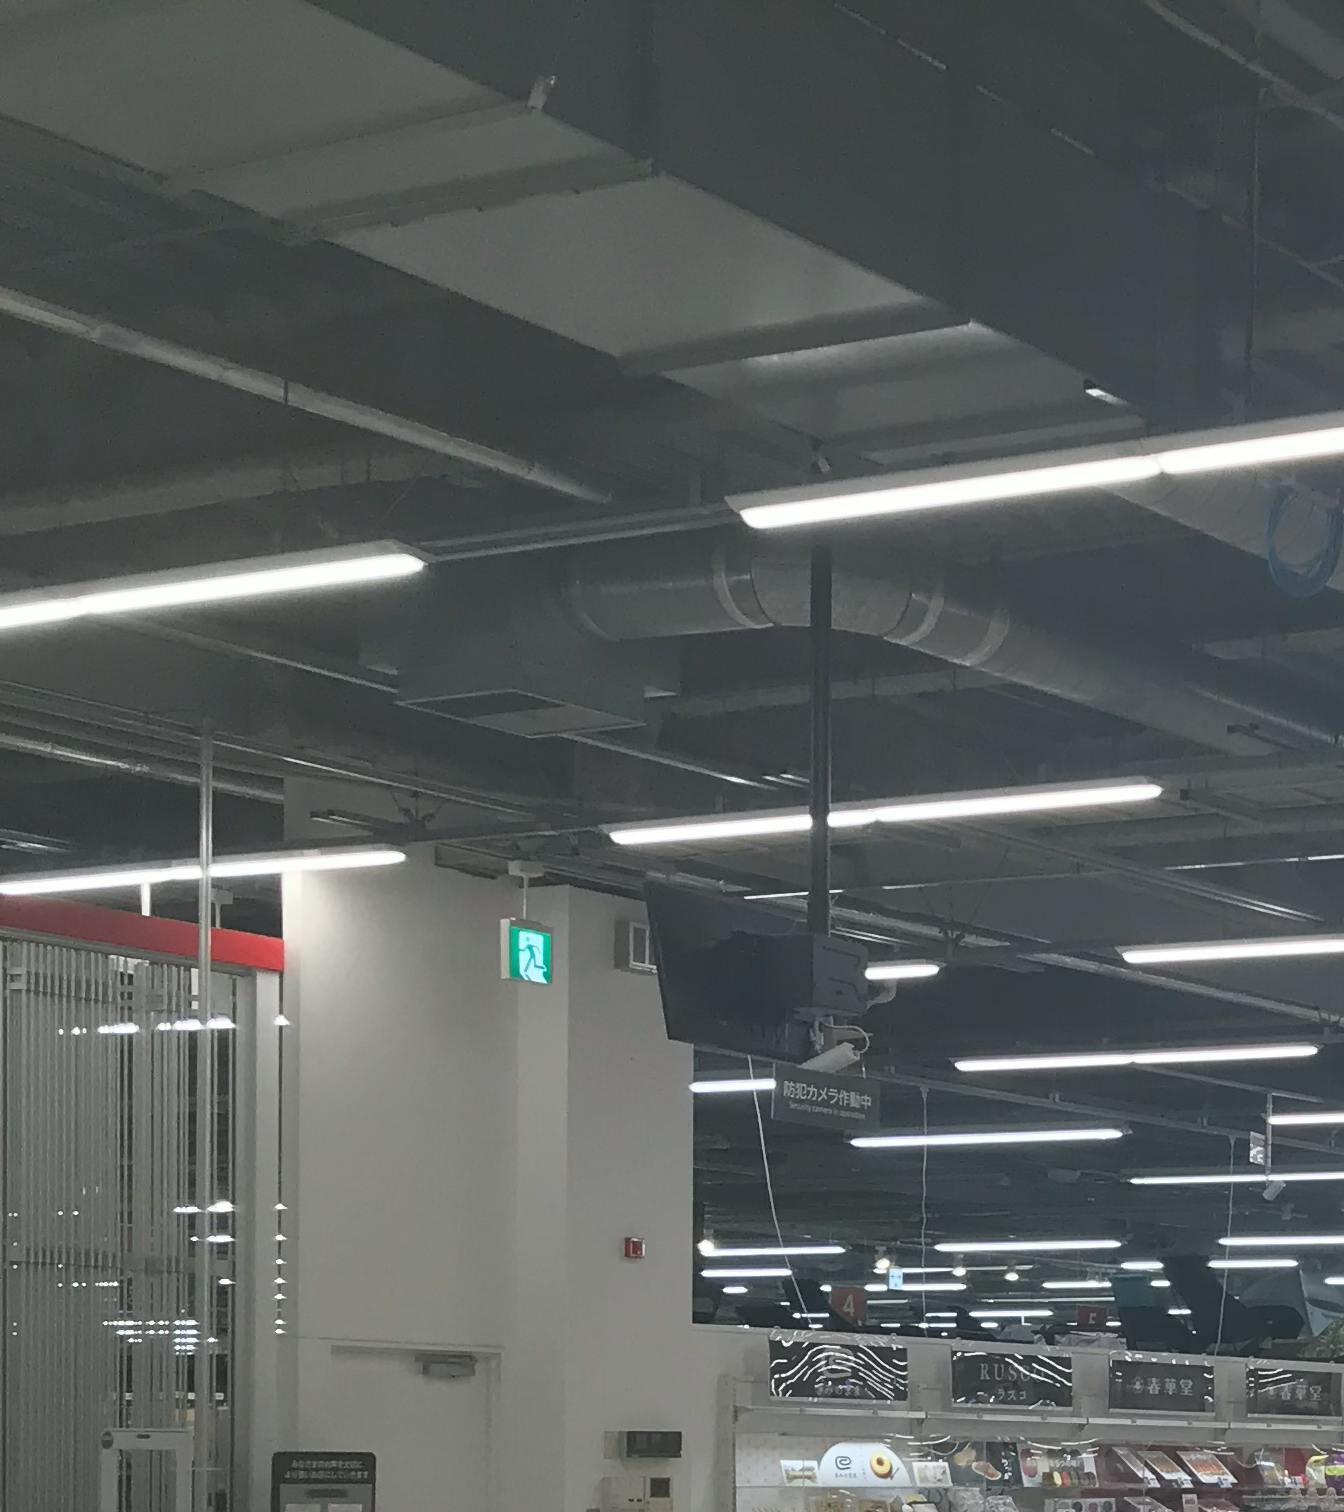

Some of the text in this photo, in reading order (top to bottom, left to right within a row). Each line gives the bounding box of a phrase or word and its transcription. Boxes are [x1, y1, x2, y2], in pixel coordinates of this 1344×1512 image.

[784, 1080, 872, 1109] 防犯カメラ作動中
[842, 1294, 854, 1315] 4
